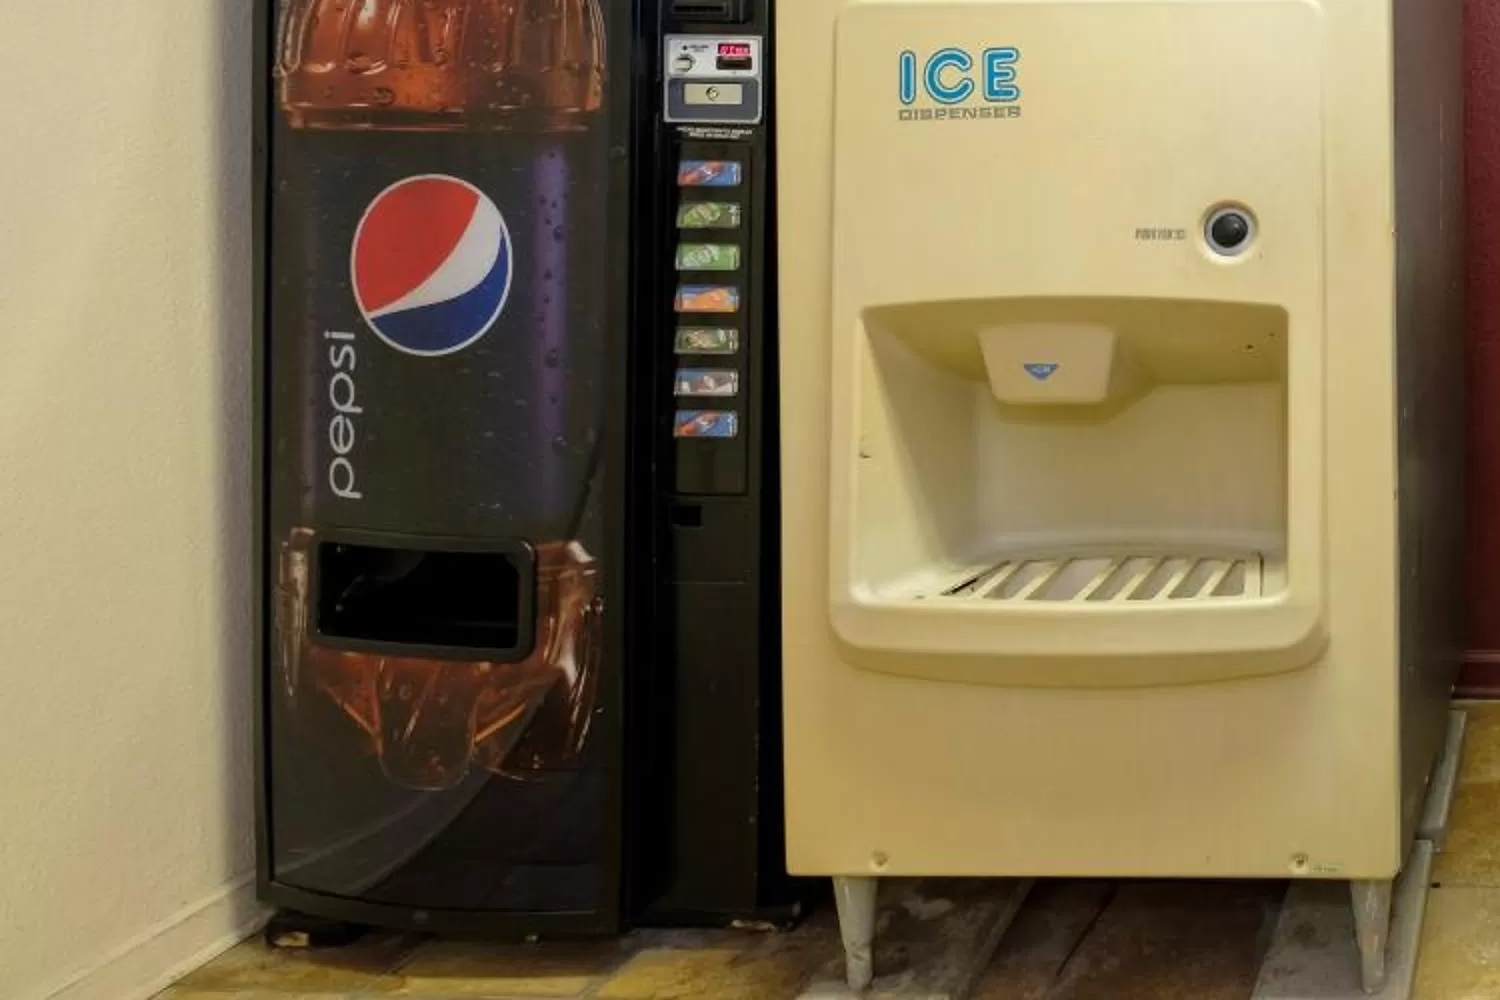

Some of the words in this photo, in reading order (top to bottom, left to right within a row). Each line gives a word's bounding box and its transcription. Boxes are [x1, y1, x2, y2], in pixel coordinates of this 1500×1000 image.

[899, 47, 1020, 105] ICE
[898, 106, 1021, 120] DISPENSER
[324, 330, 363, 499] pepsi
